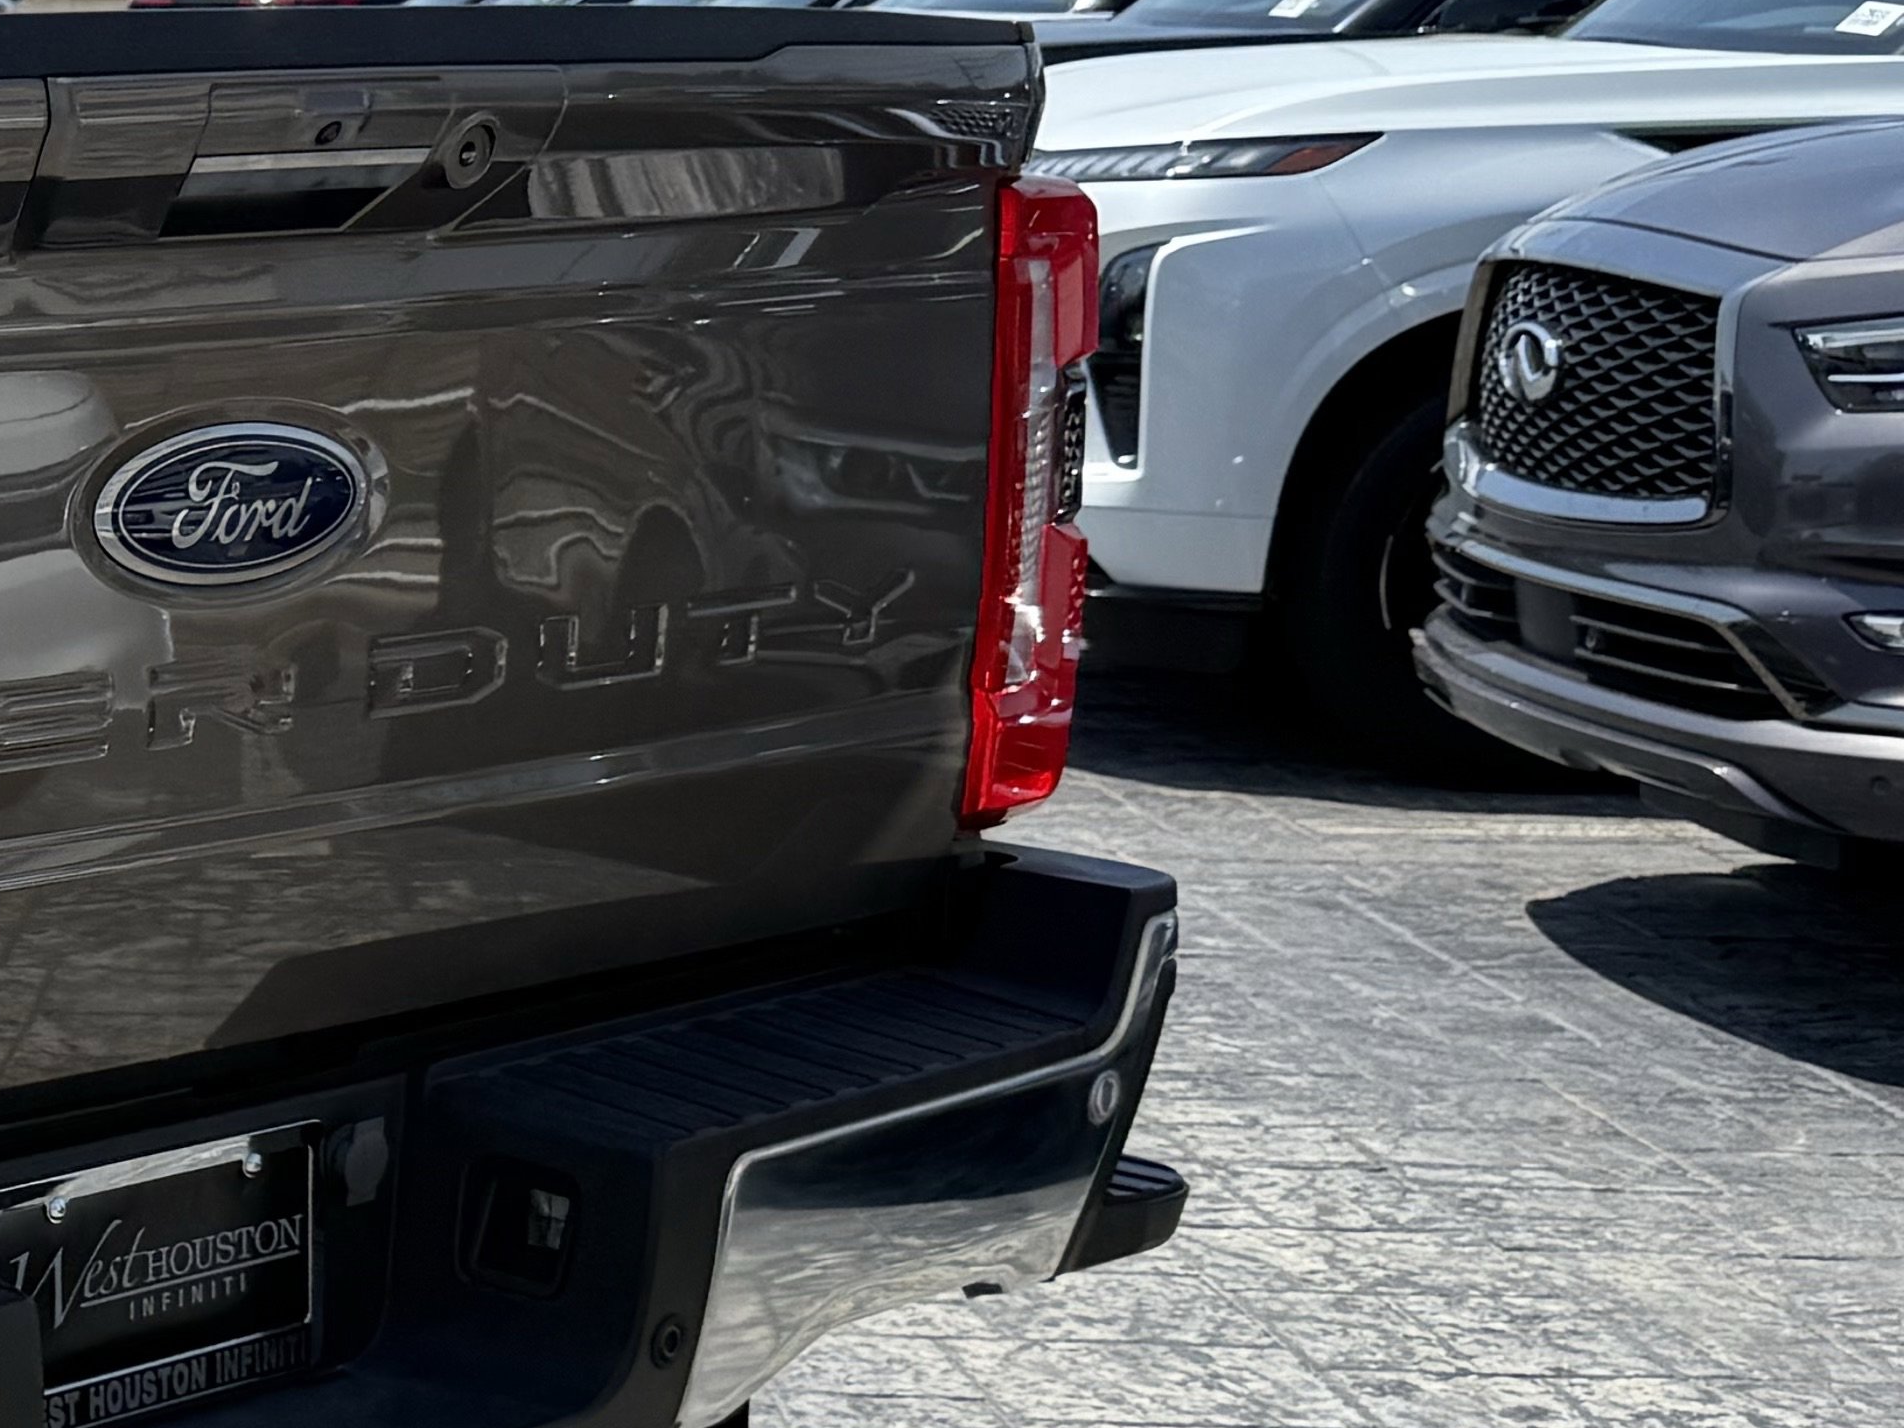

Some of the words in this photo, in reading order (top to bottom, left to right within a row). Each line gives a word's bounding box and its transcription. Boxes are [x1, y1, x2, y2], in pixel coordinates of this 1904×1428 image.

[171, 460, 314, 549] Ford
[368, 570, 915, 720] DUTY
[9, 1219, 146, 1329] West
[146, 1214, 305, 1283] HOUSTON
[128, 1273, 247, 1321] INFINITI
[89, 1357, 207, 1421] HOUSTON
[215, 1329, 307, 1384] INFINITI
